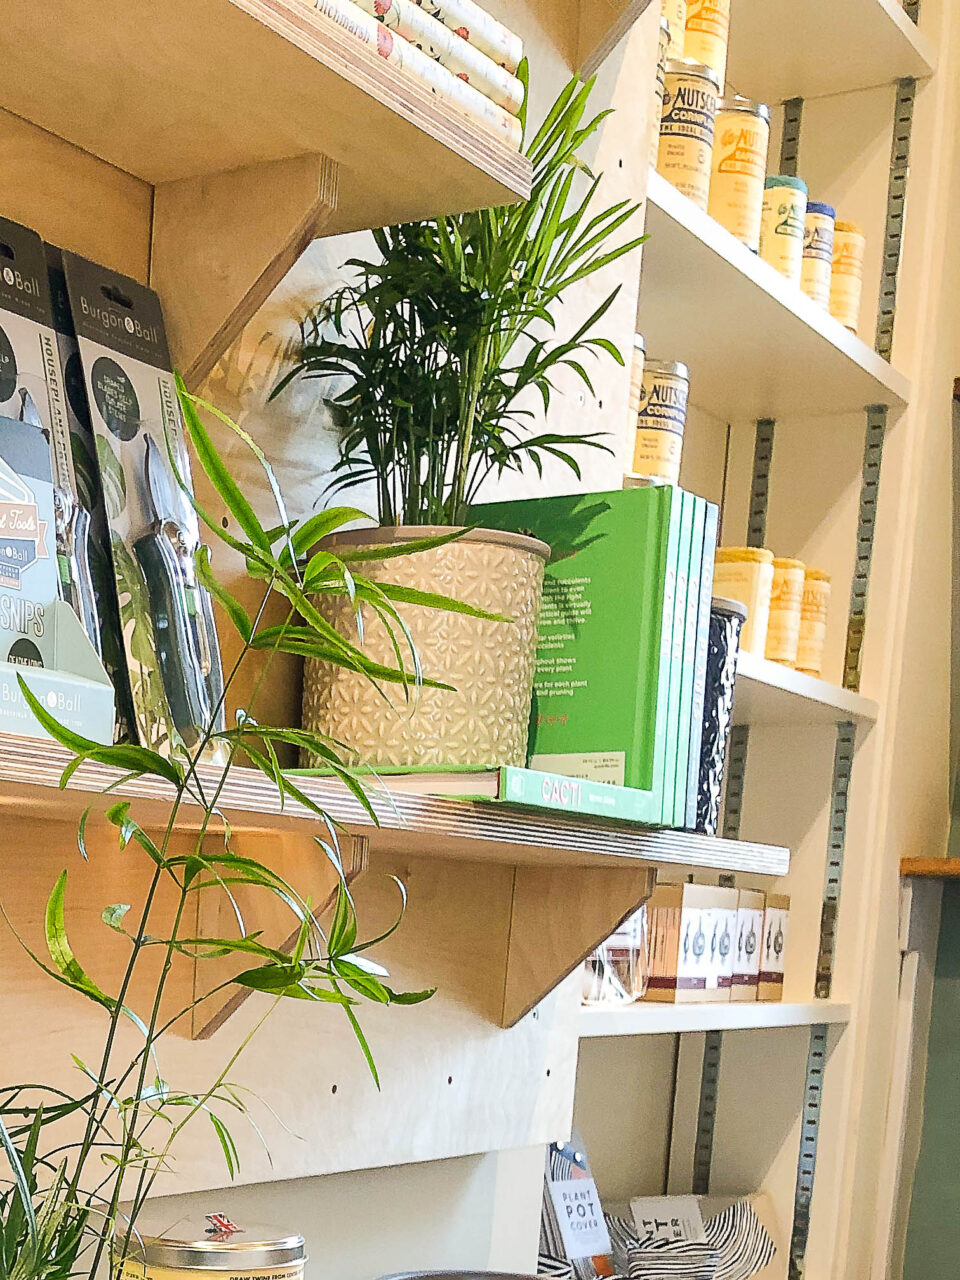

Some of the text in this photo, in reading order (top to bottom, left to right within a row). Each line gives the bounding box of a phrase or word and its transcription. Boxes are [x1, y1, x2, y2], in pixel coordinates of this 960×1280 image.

[15, 271, 40, 297] Ball
[80, 296, 124, 328] Burgon
[135, 318, 158, 344] Ball
[10, 509, 37, 531] Tools
[13, 547, 28, 562] Ball
[0, 593, 45, 638] SNIPS
[549, 689, 574, 698] pruning
[570, 680, 588, 688] plant
[58, 691, 81, 713] Ball
[542, 776, 582, 808] CACTI
[562, 1190, 591, 1202] PLANT
[566, 1203, 595, 1219] POT
[570, 1219, 598, 1231] COVER
